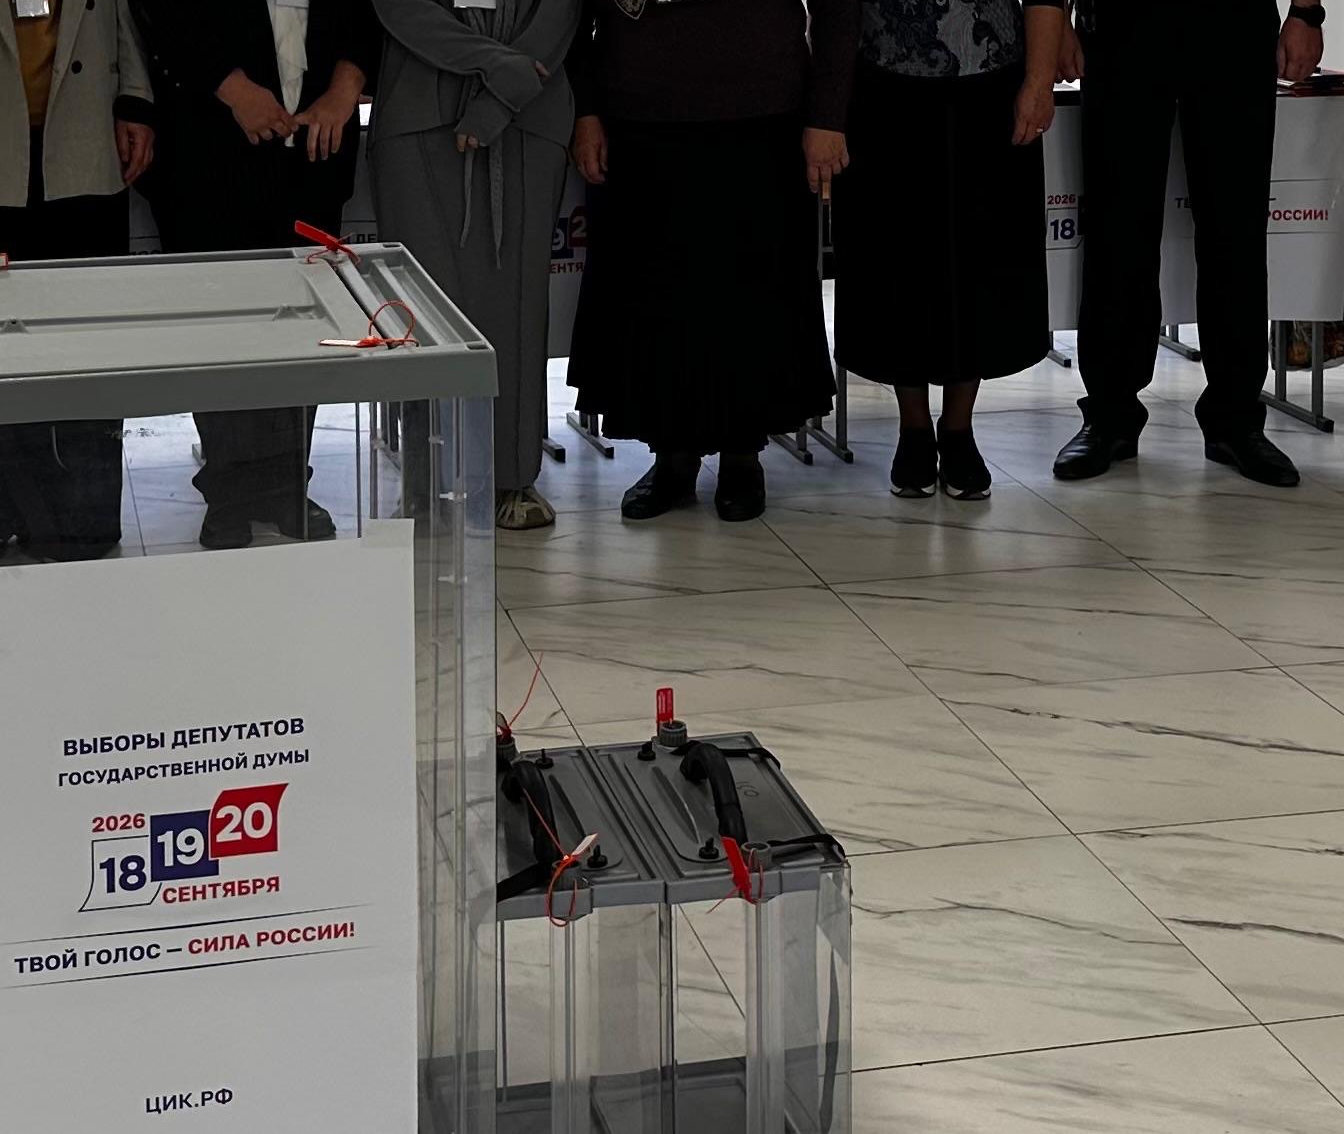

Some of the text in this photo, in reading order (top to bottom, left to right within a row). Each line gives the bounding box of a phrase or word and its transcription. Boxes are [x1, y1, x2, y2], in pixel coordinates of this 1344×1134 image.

[1047, 194, 1076, 206] 2026
[1049, 218, 1076, 241] 18
[63, 717, 305, 757] ВЫБОРЫ ДЕПУТАТОВ
[58, 749, 310, 788] ГОСУДАРСТВЕННОЙ ДУМЫ
[92, 813, 146, 833] 2026
[99, 801, 274, 893] 18 19 20
[162, 876, 281, 905] СЕНТЯБРЯ
[15, 948, 78, 975] ТВОЙ
[84, 943, 161, 968] ГОЛОС
[188, 933, 250, 957] СИЛА
[256, 922, 356, 948] РОССИИ!
[145, 1087, 234, 1115] ЦИК.РФ
